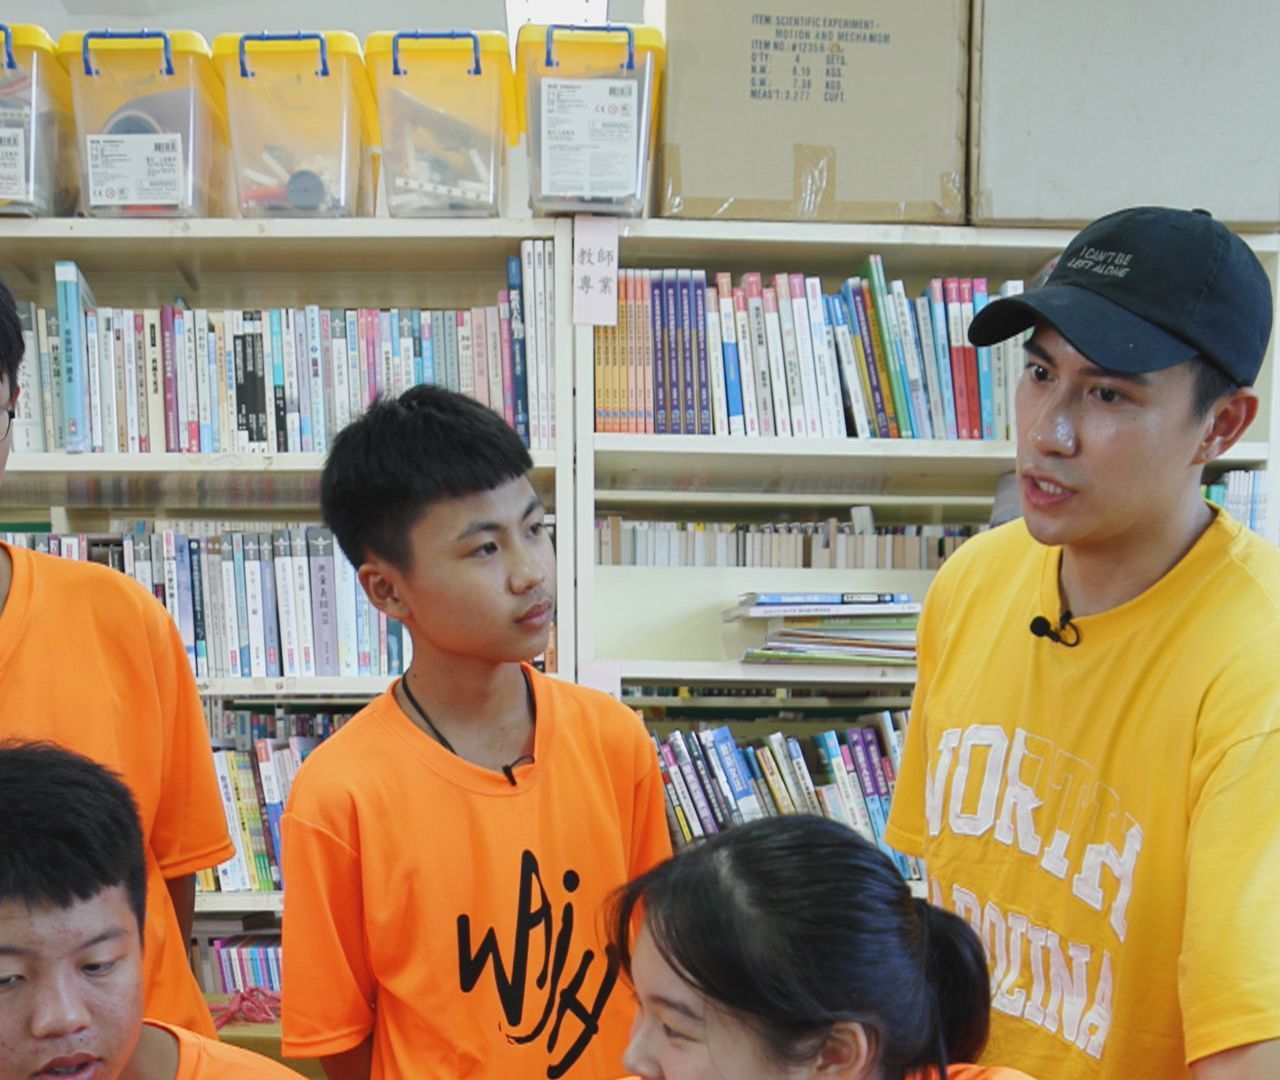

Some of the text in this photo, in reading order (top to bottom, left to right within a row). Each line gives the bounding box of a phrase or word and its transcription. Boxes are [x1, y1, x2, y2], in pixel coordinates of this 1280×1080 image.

[776, 15, 820, 28] SCIENTIFIC
[775, 29, 891, 43] MOTION AND MECHANISM
[577, 247, 615, 266] 教師
[577, 274, 613, 295] 專業
